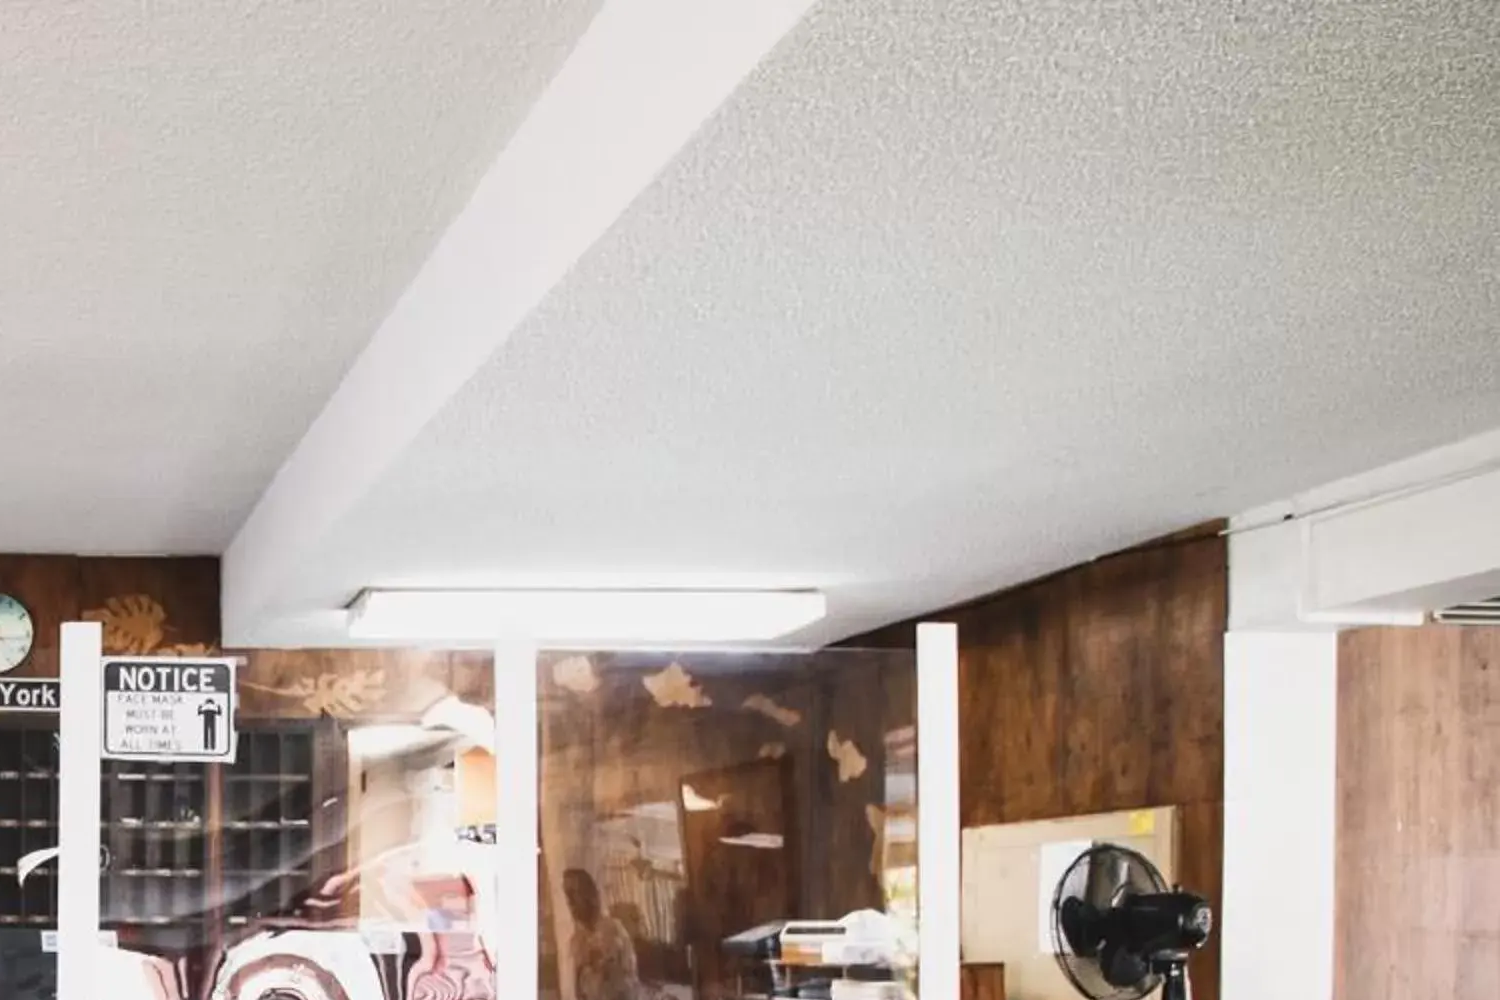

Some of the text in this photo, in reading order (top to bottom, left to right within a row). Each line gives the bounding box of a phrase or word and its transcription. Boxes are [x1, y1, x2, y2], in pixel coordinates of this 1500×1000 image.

[119, 666, 216, 692] NOTICE
[117, 694, 184, 705] FACE MASK
[126, 709, 157, 720] MUST
[125, 725, 177, 736] WORN AT
[120, 739, 141, 750] ALL
